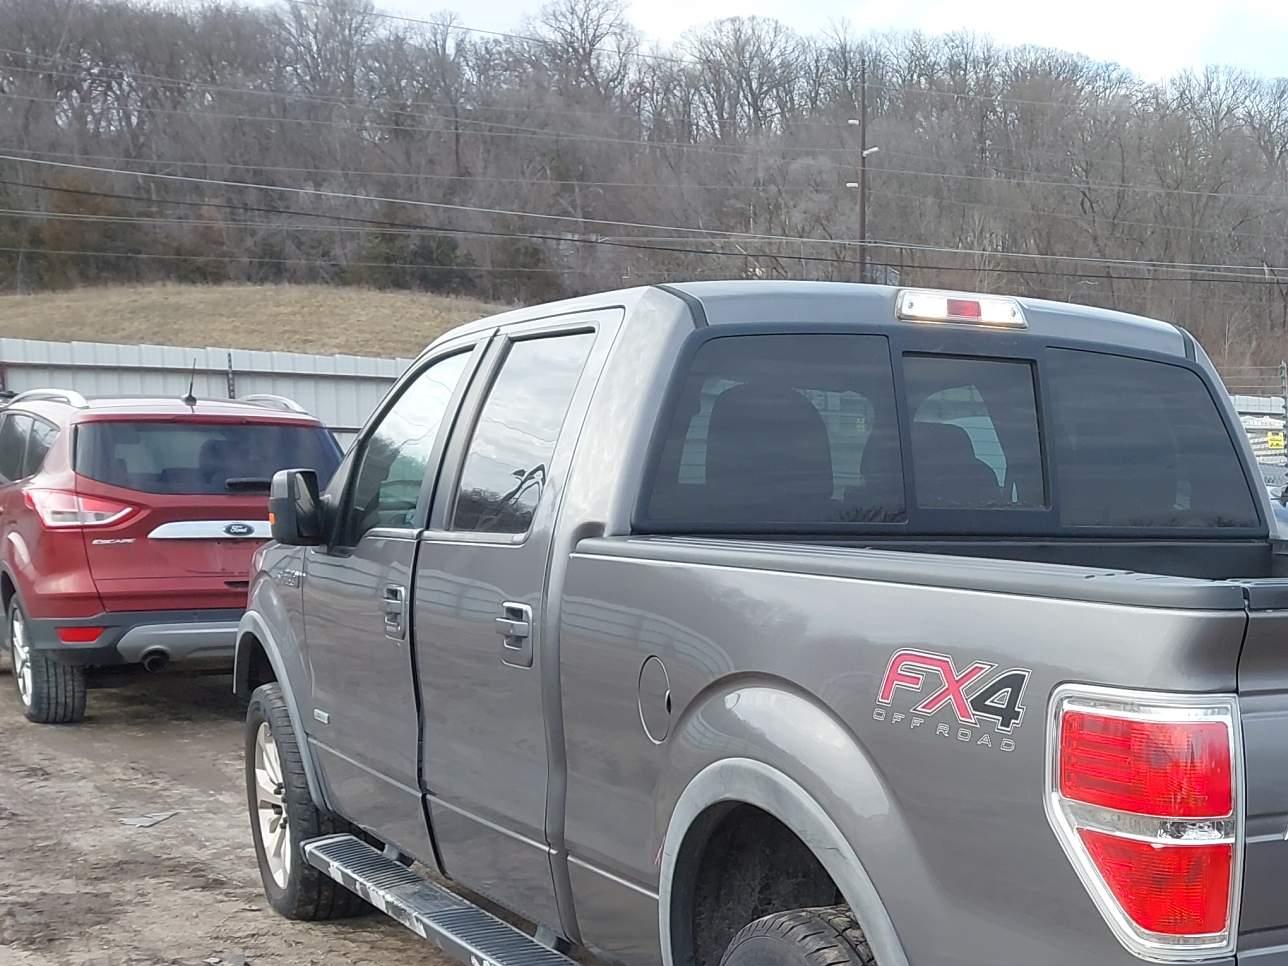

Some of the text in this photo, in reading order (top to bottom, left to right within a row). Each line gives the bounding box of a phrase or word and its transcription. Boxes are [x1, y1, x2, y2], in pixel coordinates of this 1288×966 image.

[876, 648, 1033, 735] FX4
[872, 708, 1016, 752] OFF ROAD
